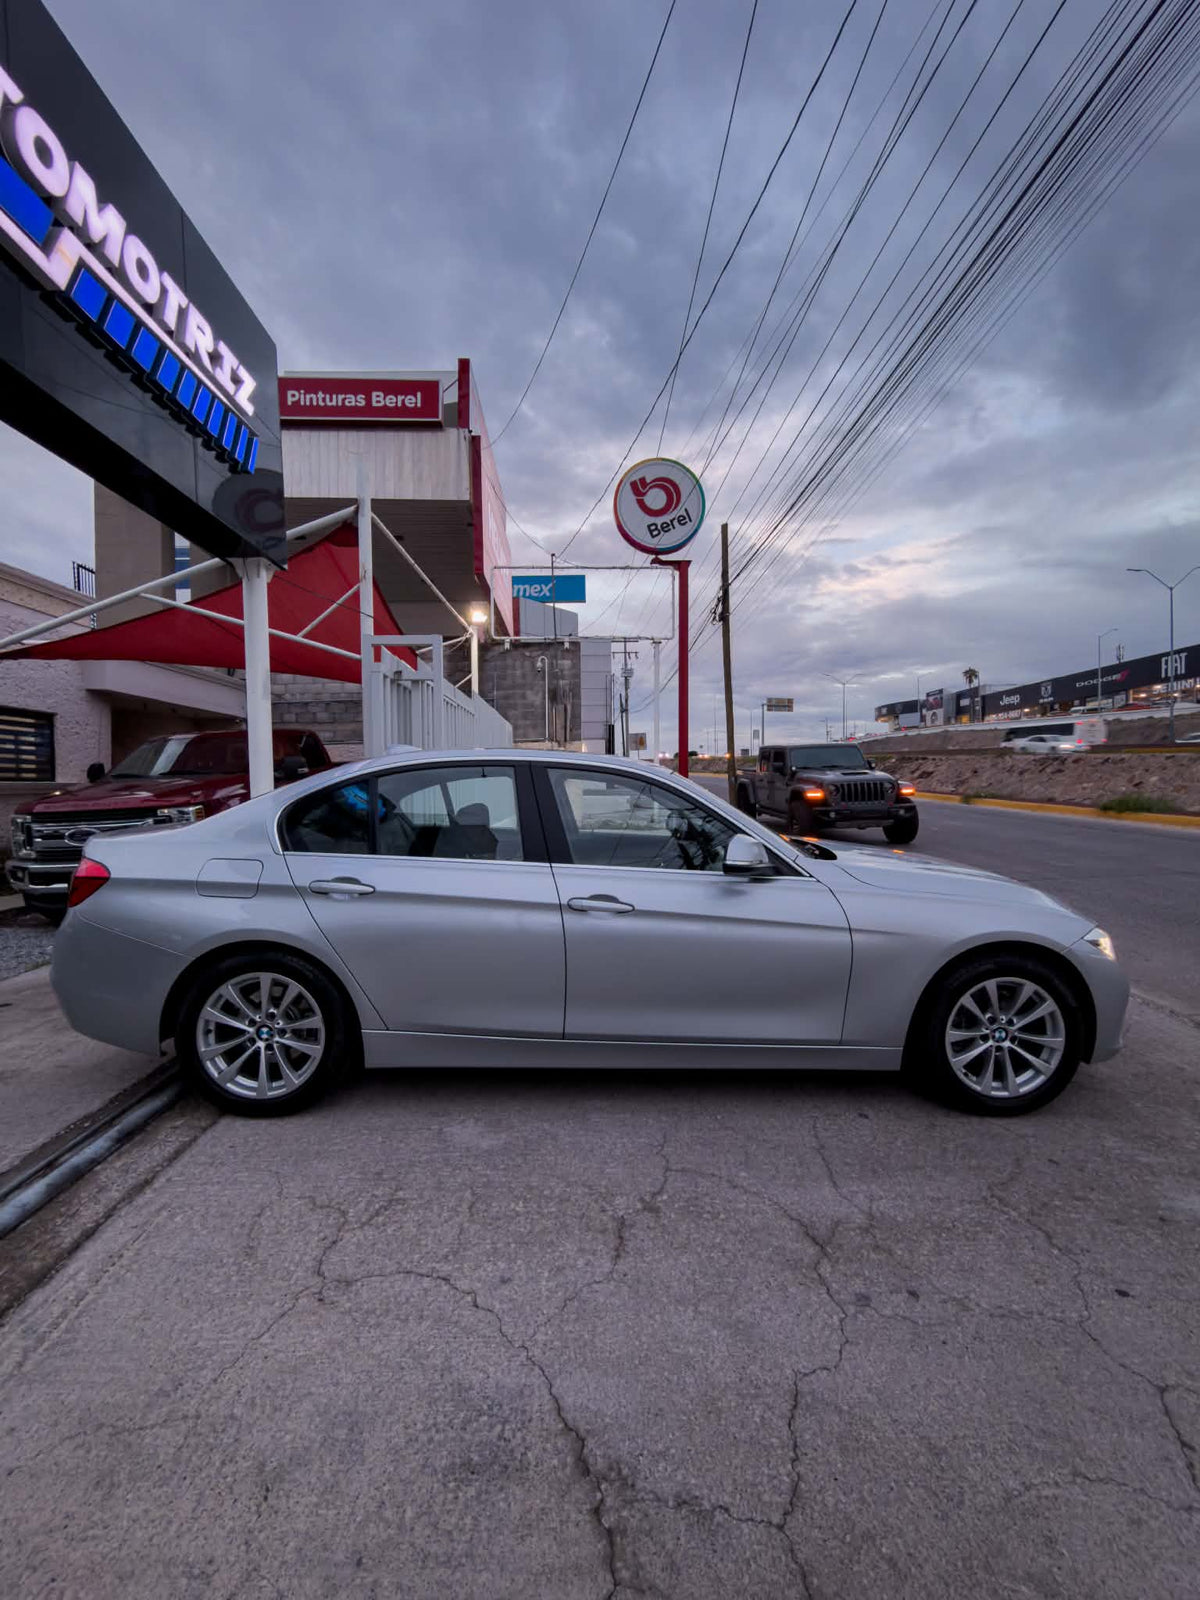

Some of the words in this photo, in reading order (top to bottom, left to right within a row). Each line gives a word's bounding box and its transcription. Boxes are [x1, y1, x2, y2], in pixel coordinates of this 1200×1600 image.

[287, 390, 366, 407] Pinturas
[371, 391, 422, 408] Berel
[646, 507, 693, 539] Berel
[1161, 652, 1188, 679] FIAT
[1000, 694, 1020, 706] Jeep
